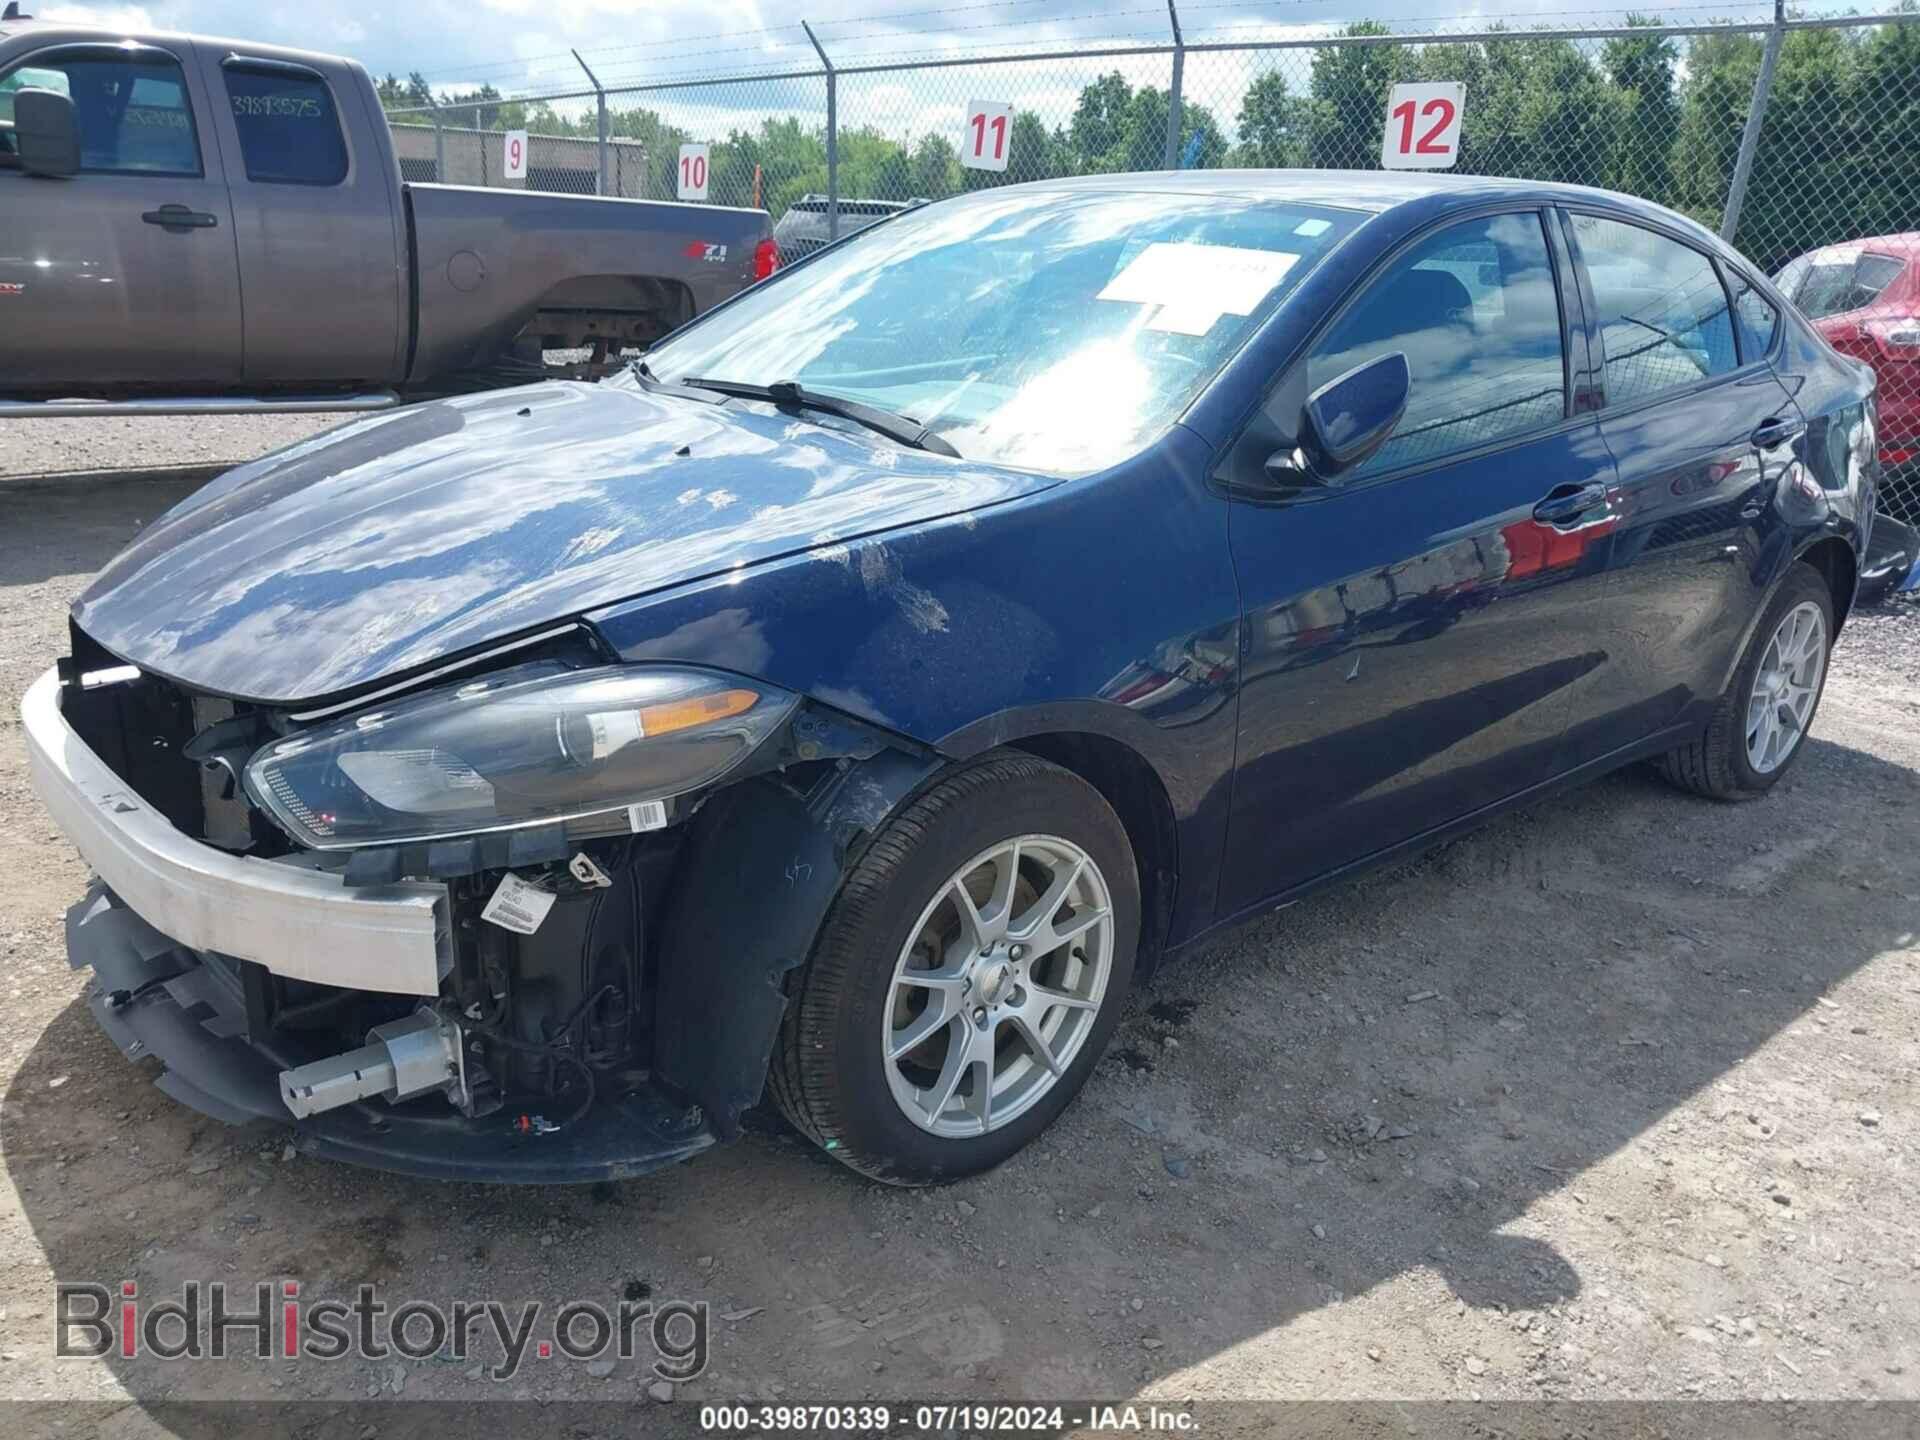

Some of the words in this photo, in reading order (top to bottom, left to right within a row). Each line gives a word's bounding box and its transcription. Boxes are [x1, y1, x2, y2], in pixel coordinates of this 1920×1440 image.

[972, 113, 1006, 159] 11
[1393, 98, 1455, 154] 12
[511, 139, 521, 170] 9
[681, 156, 705, 189] 10
